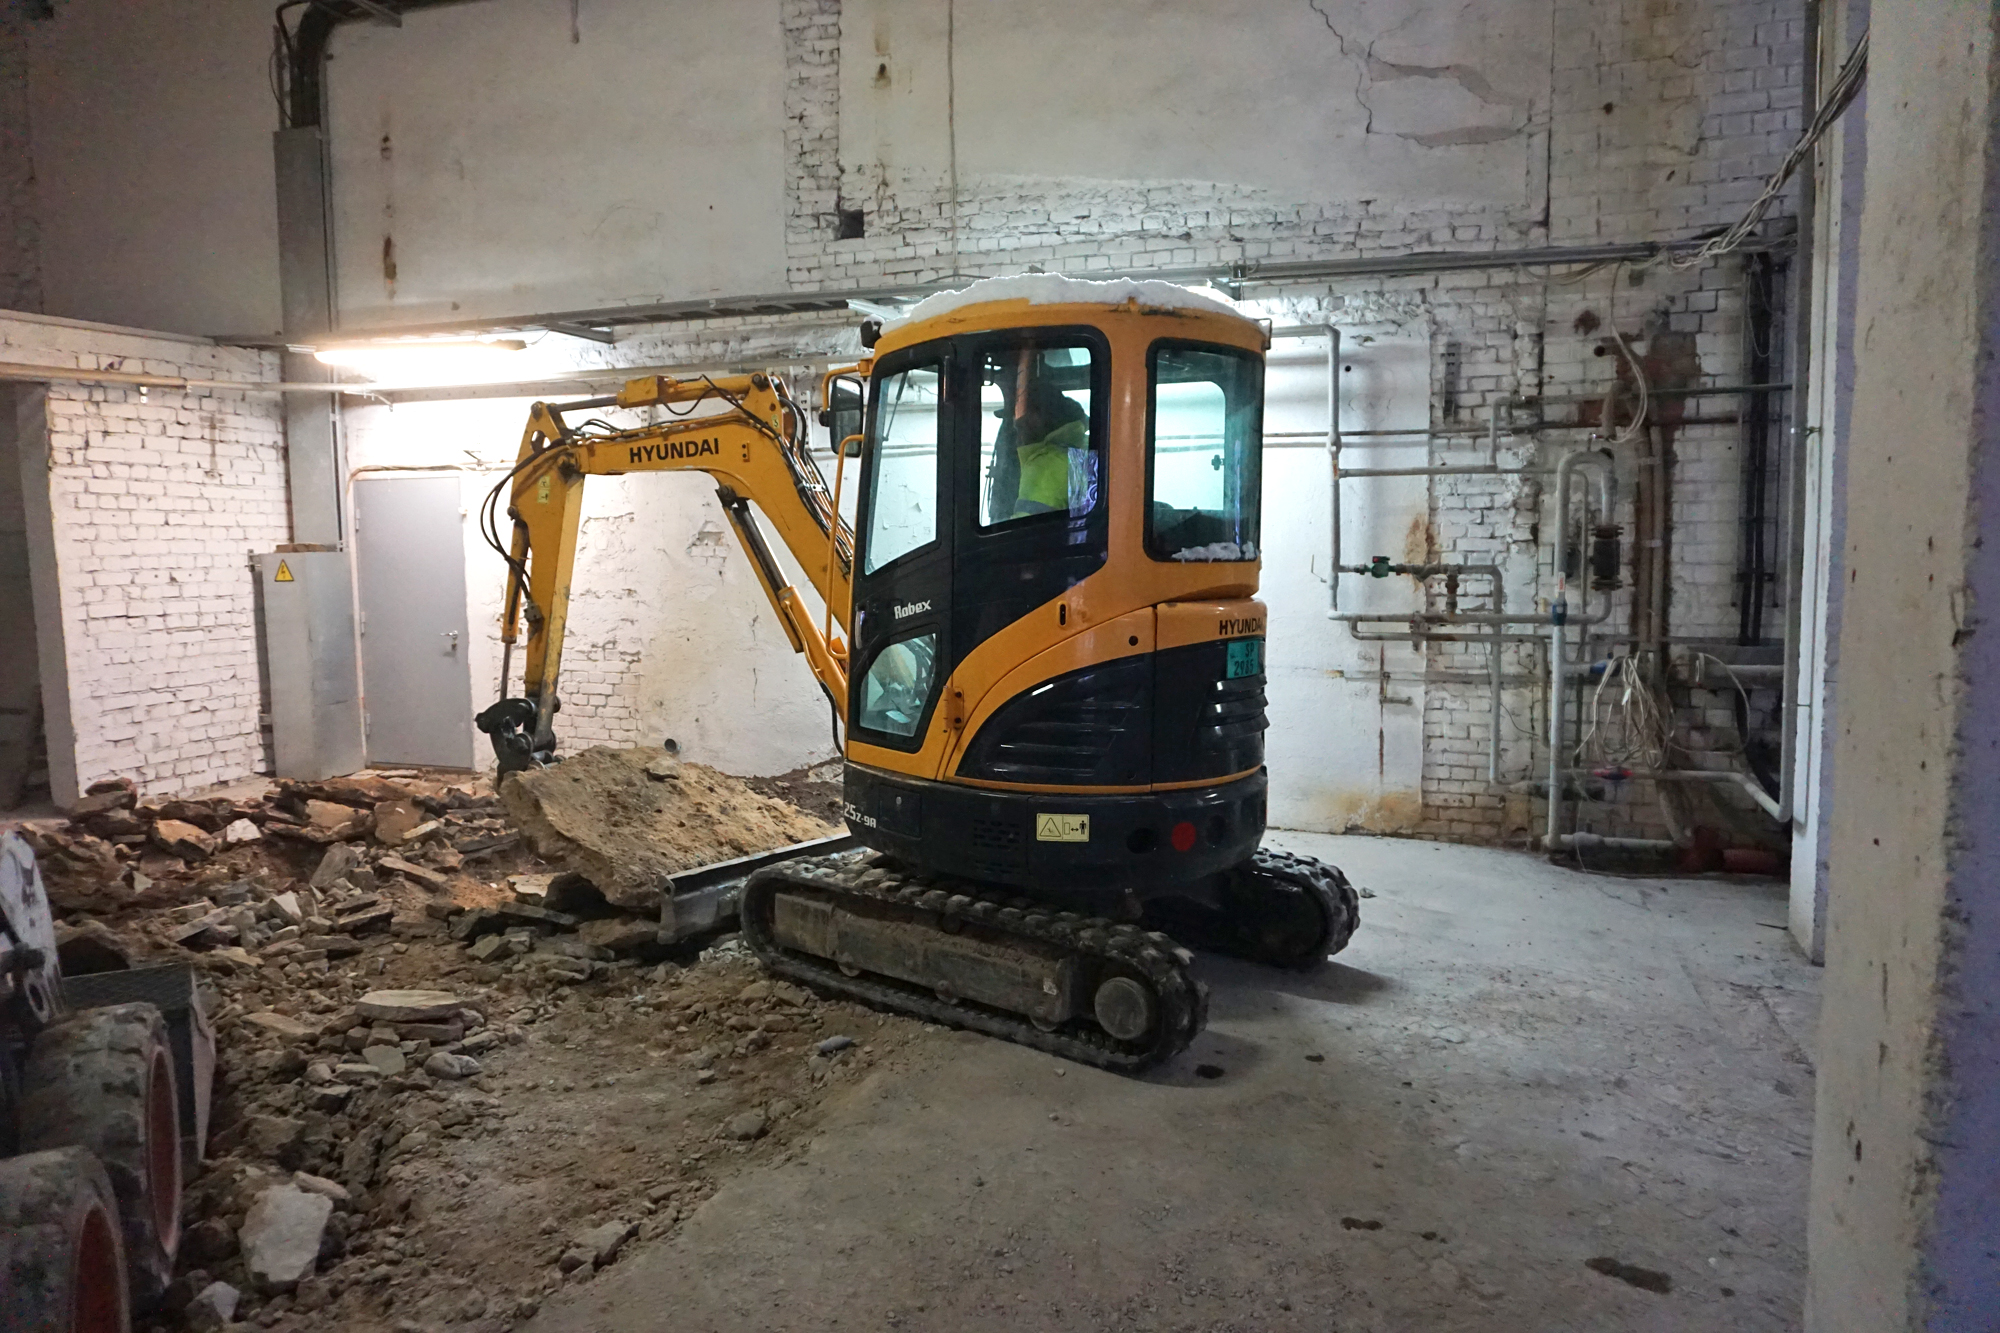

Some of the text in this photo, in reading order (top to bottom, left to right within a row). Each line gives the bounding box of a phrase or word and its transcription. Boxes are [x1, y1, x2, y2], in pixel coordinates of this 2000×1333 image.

[629, 438, 719, 463] HYUNDAI
[893, 599, 932, 620] Robex
[1219, 617, 1264, 636] HYUNDA
